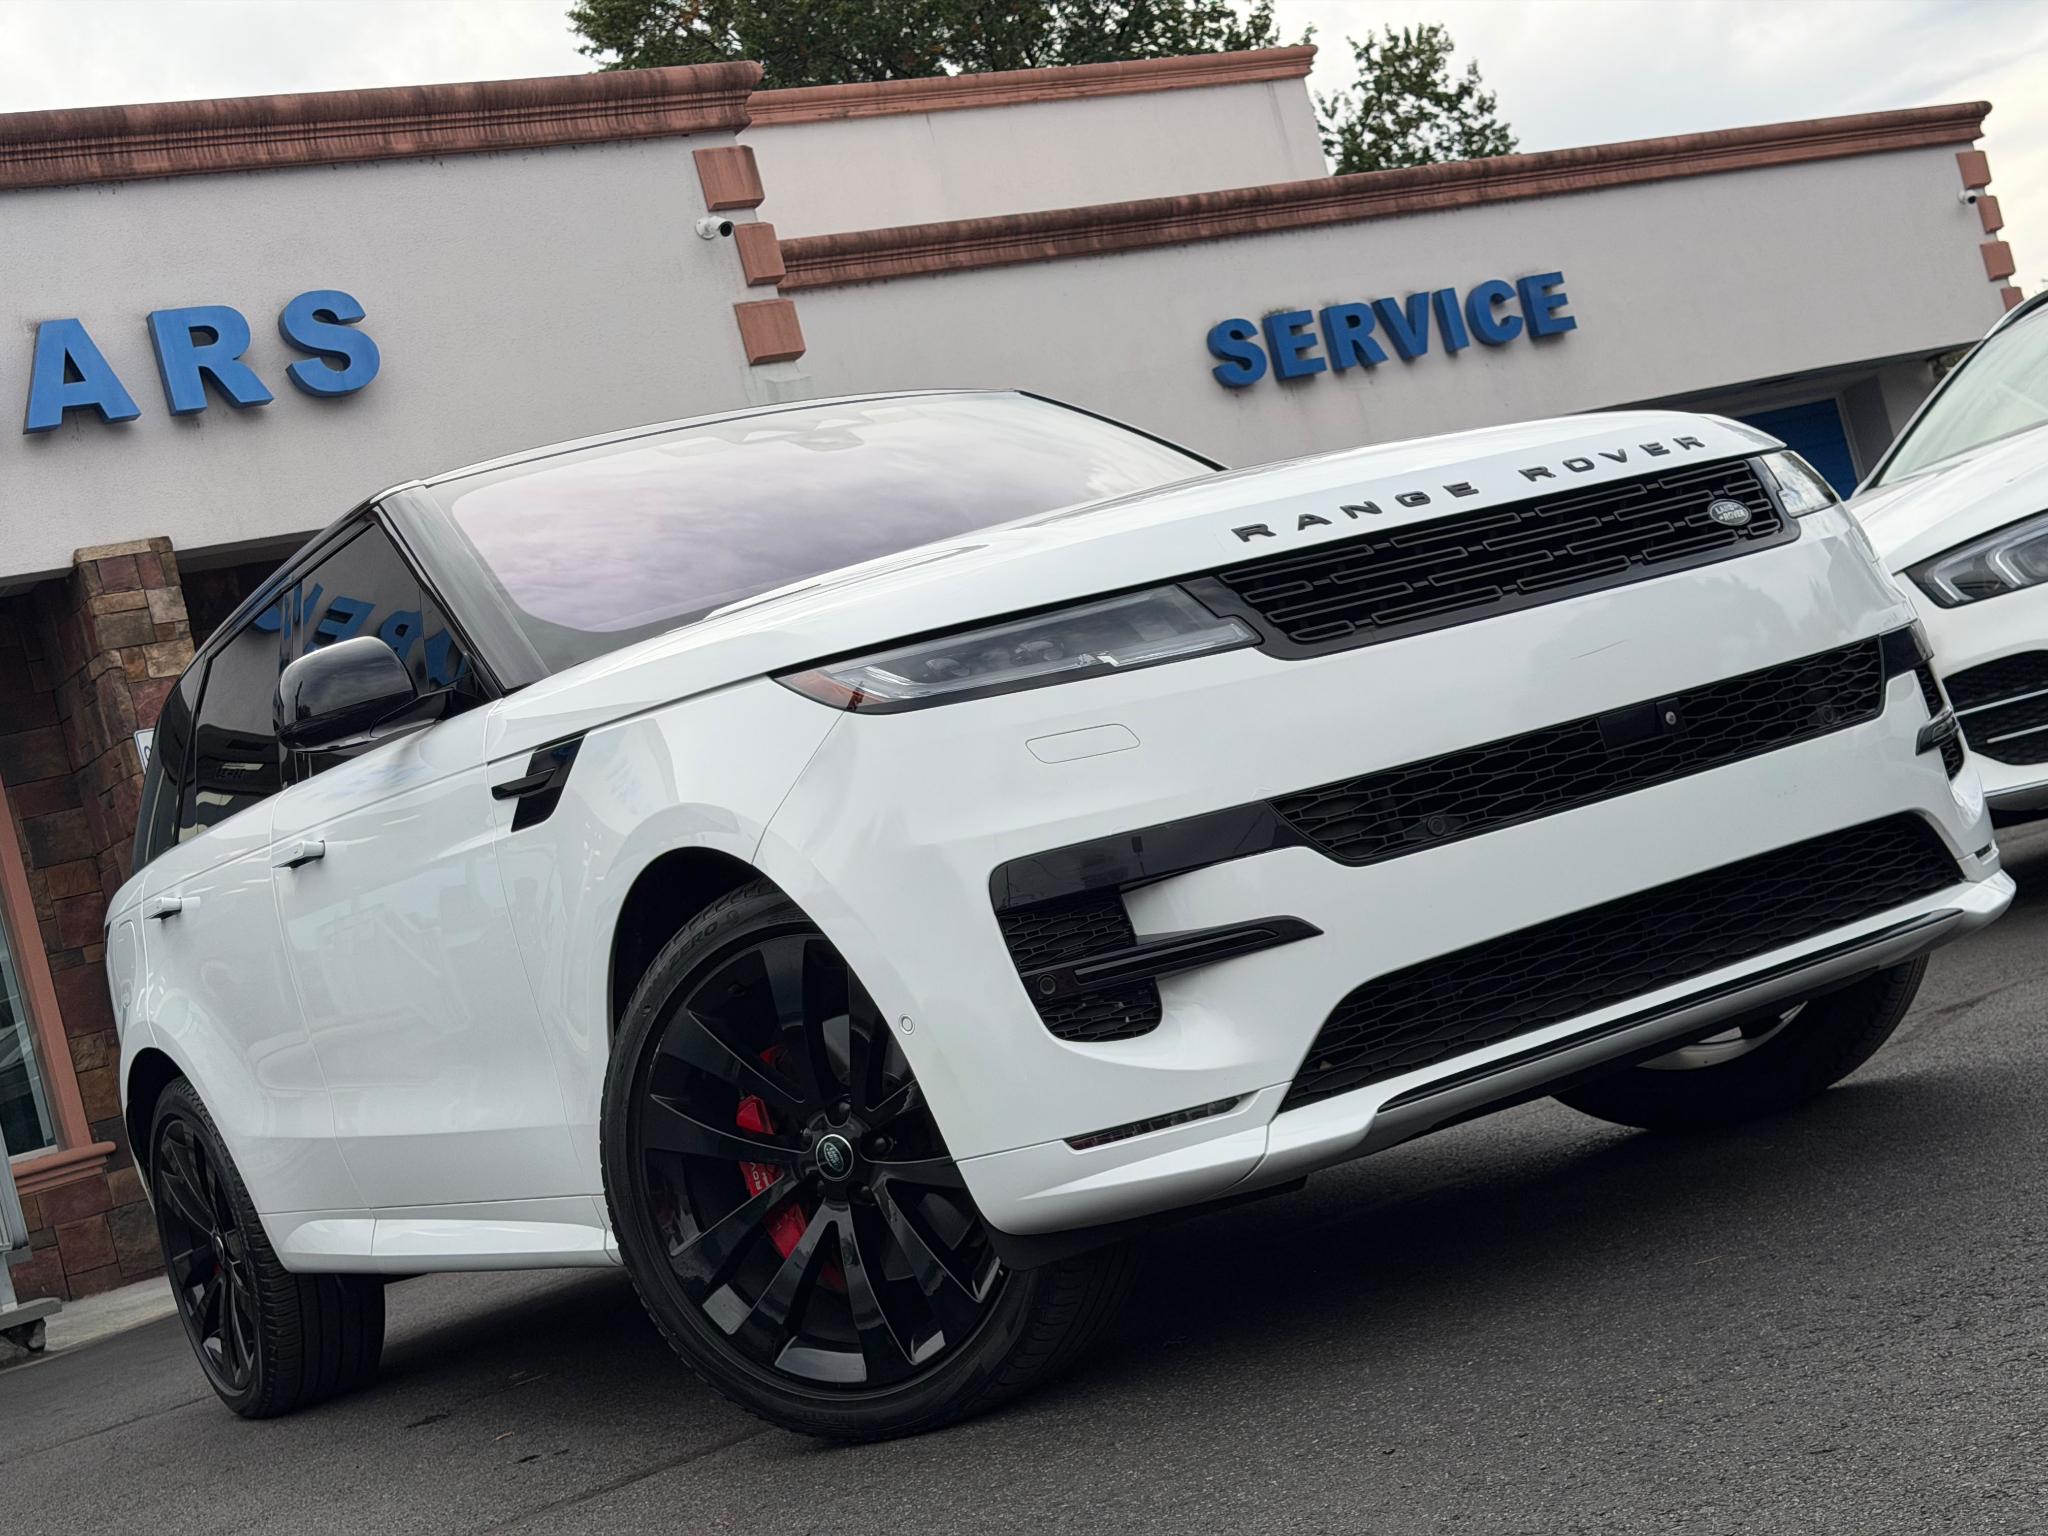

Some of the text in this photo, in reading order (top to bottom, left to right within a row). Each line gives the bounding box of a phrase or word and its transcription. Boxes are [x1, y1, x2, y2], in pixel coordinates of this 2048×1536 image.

[23, 289, 381, 434] ARS
[1206, 271, 1578, 388] SERVICE
[1231, 436, 1706, 543] RANGE ROVER
